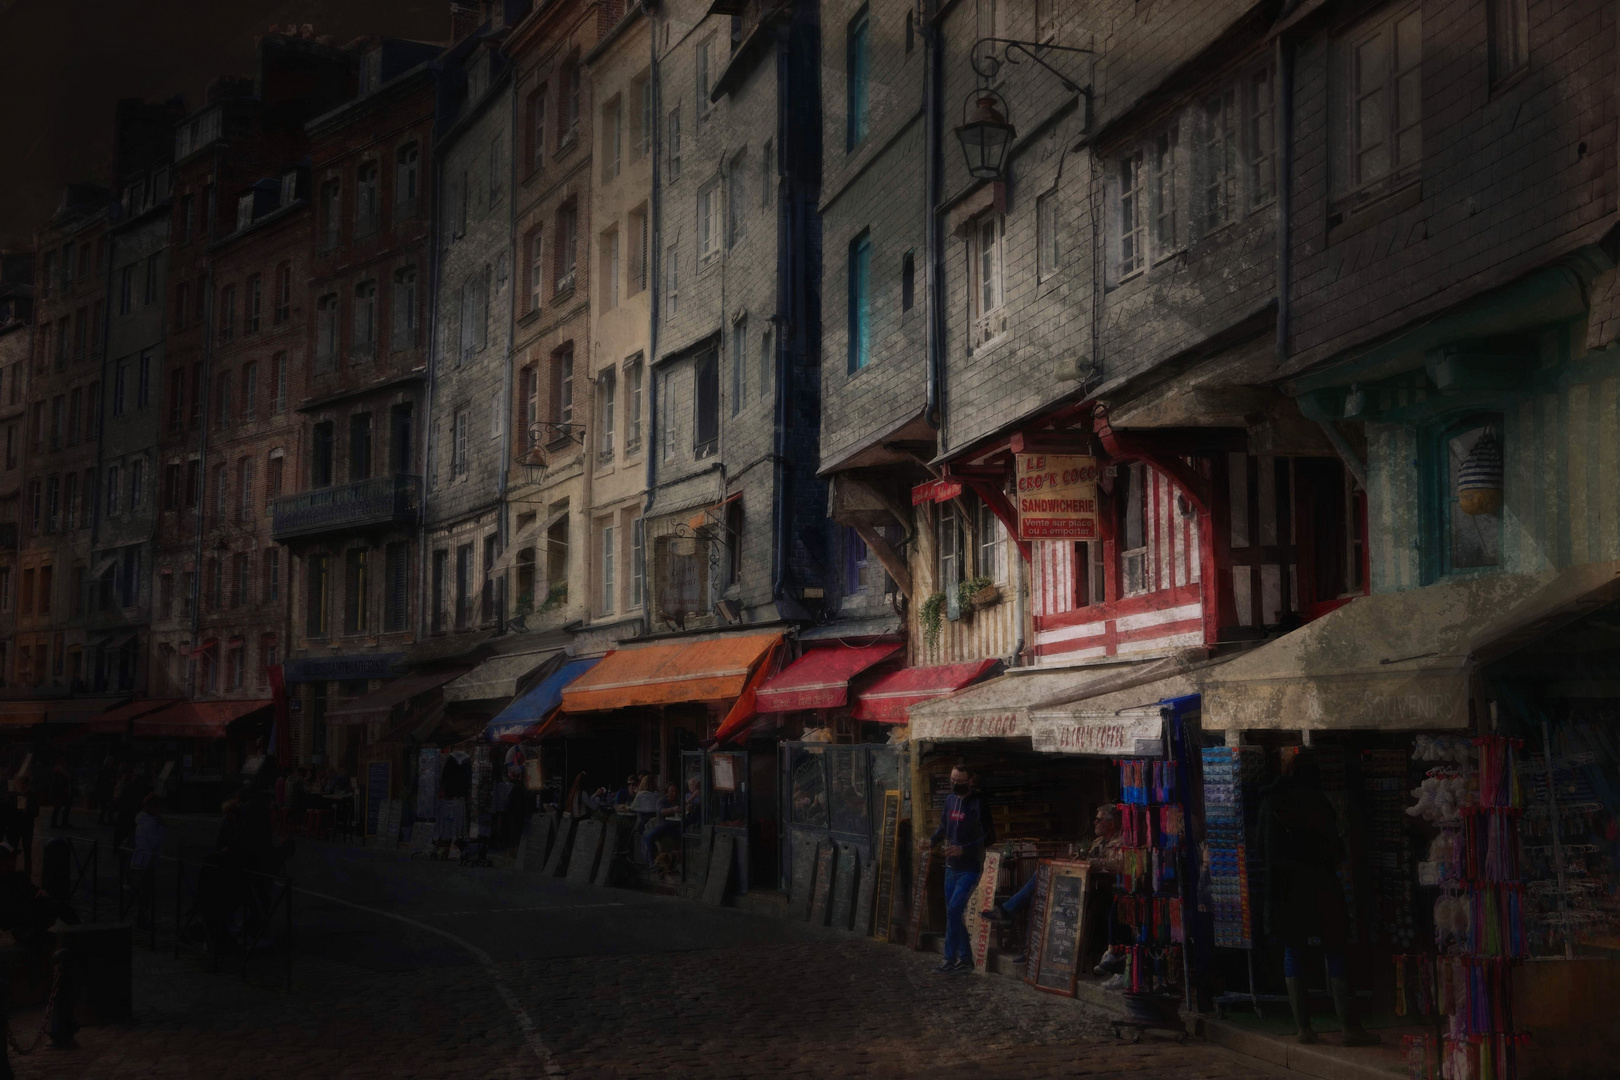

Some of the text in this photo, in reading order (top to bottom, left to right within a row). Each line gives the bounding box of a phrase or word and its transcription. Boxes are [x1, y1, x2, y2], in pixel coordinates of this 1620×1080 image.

[1026, 455, 1046, 472] LE
[1018, 465, 1096, 491] CRO'K COCO
[1022, 499, 1094, 512] SANDWICHERIE
[1050, 528, 1090, 536] emporter
[1069, 519, 1092, 529] place
[1364, 690, 1454, 720] SOUVENIRS
[988, 713, 1017, 735] COCO
